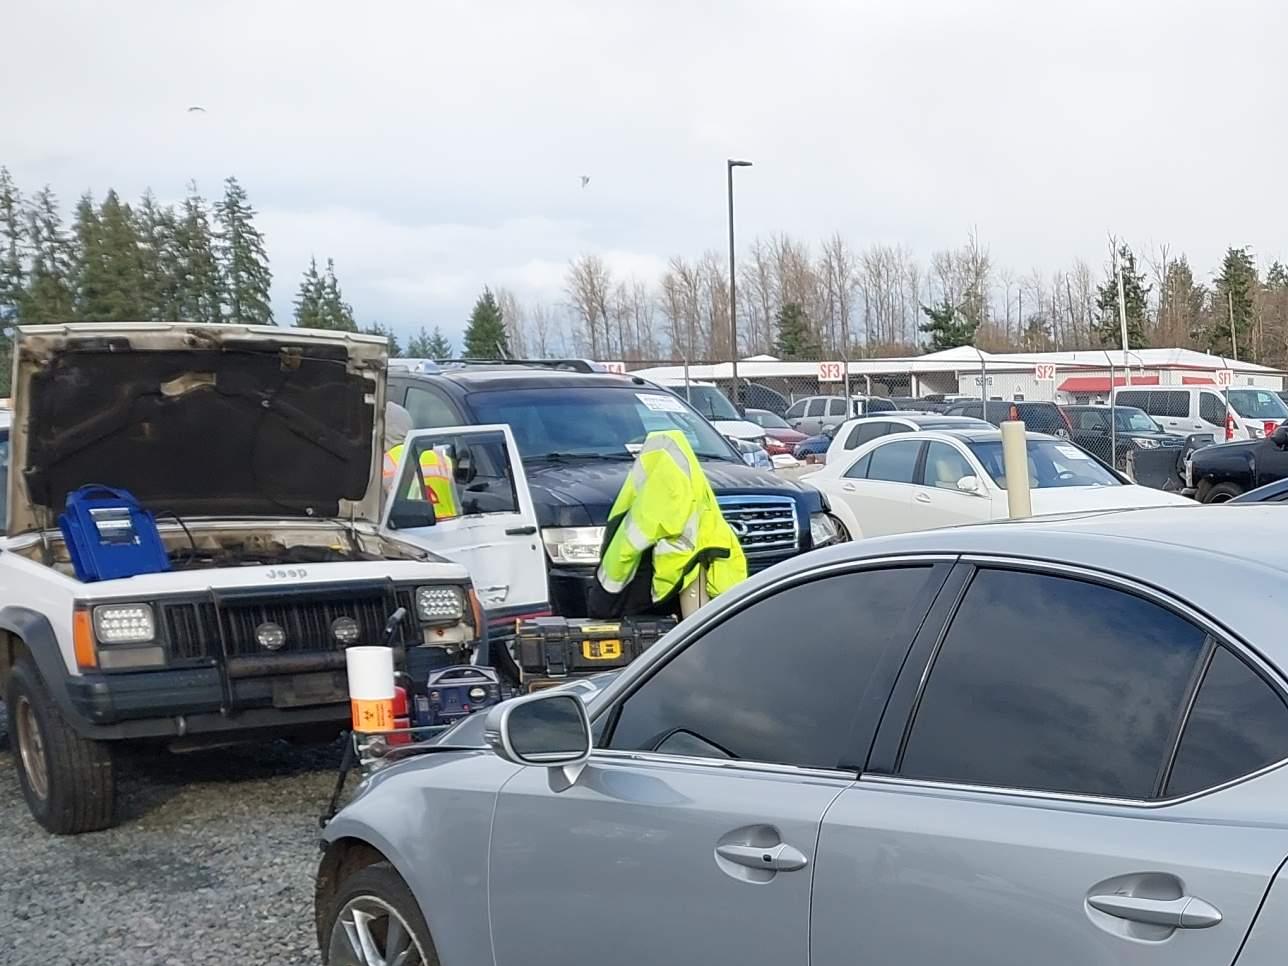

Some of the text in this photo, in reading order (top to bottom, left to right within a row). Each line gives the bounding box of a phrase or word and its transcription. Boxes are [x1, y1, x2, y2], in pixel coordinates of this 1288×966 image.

[820, 364, 840, 378] SF3
[1037, 365, 1054, 379] SF2
[1218, 372, 1231, 385] SF1
[265, 569, 308, 579] Jeep
